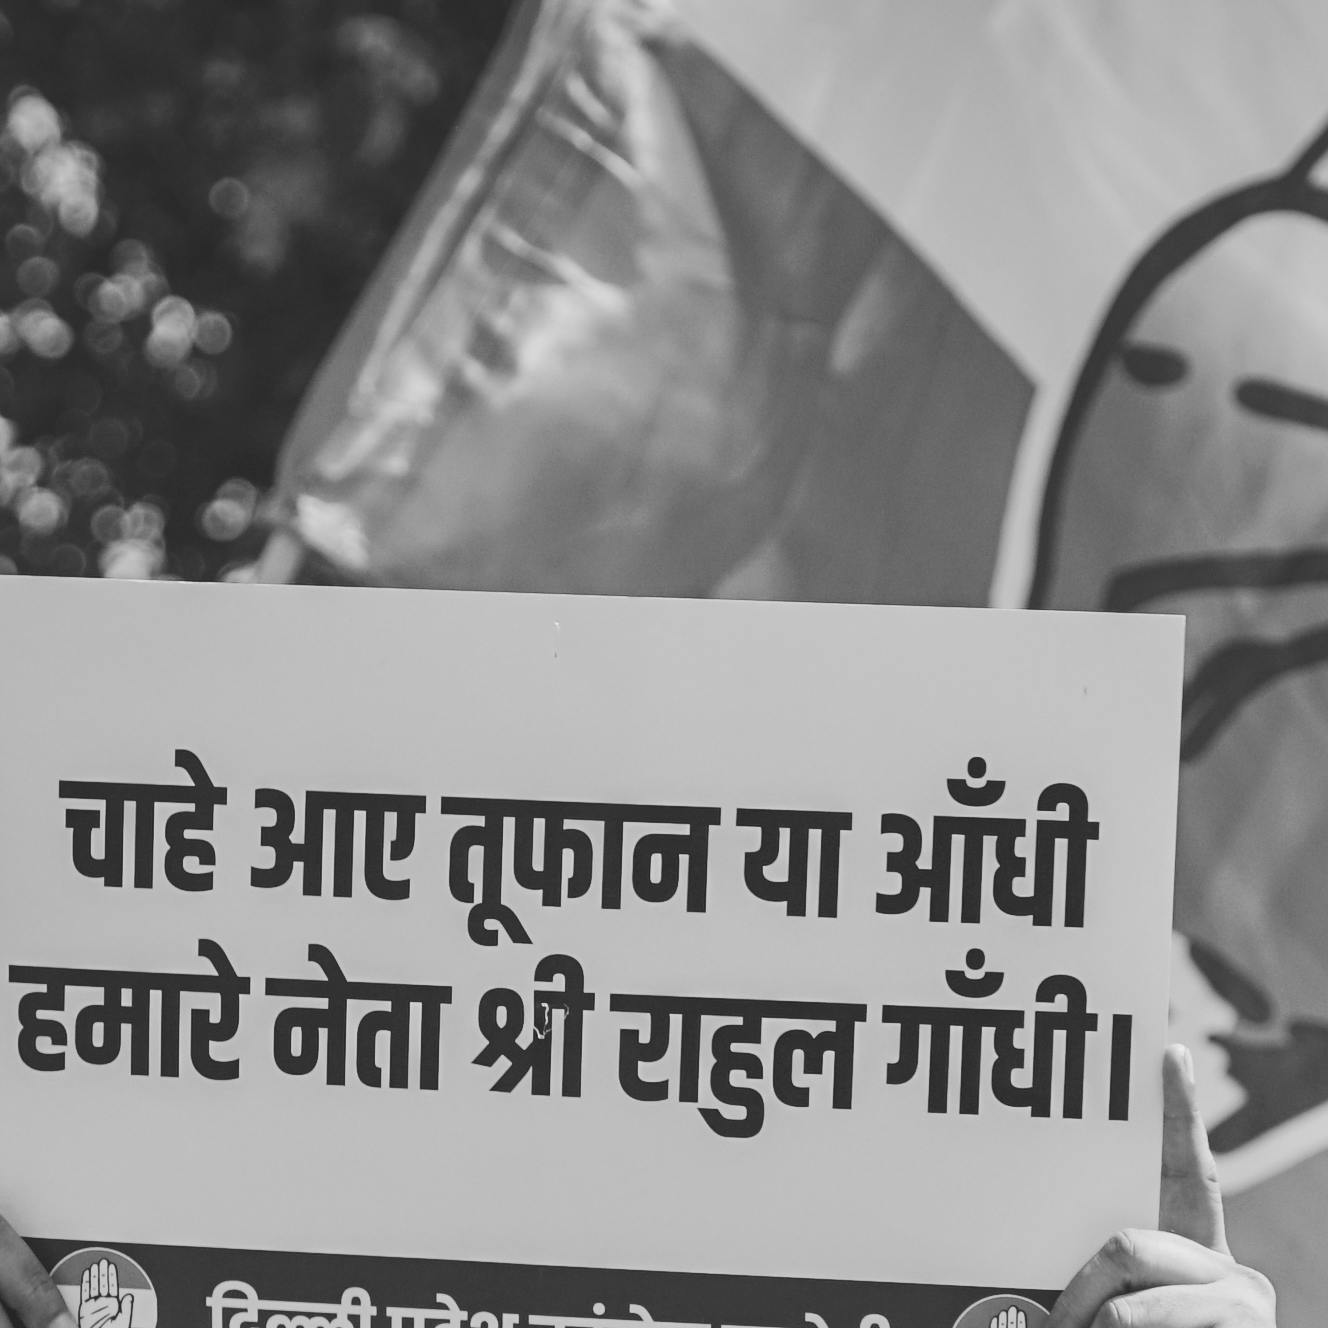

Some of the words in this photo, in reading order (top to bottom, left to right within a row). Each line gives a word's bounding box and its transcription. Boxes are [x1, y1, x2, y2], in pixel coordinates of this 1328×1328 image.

[58, 748, 228, 892] चाहे
[250, 787, 427, 901] आए
[440, 796, 722, 947] तूफान
[735, 807, 853, 919] या
[875, 756, 1100, 928] आँधी
[8, 938, 251, 1081] हमारे
[264, 943, 453, 1091] नेता
[471, 953, 596, 1098] श्री
[609, 993, 868, 1139] राहुल
